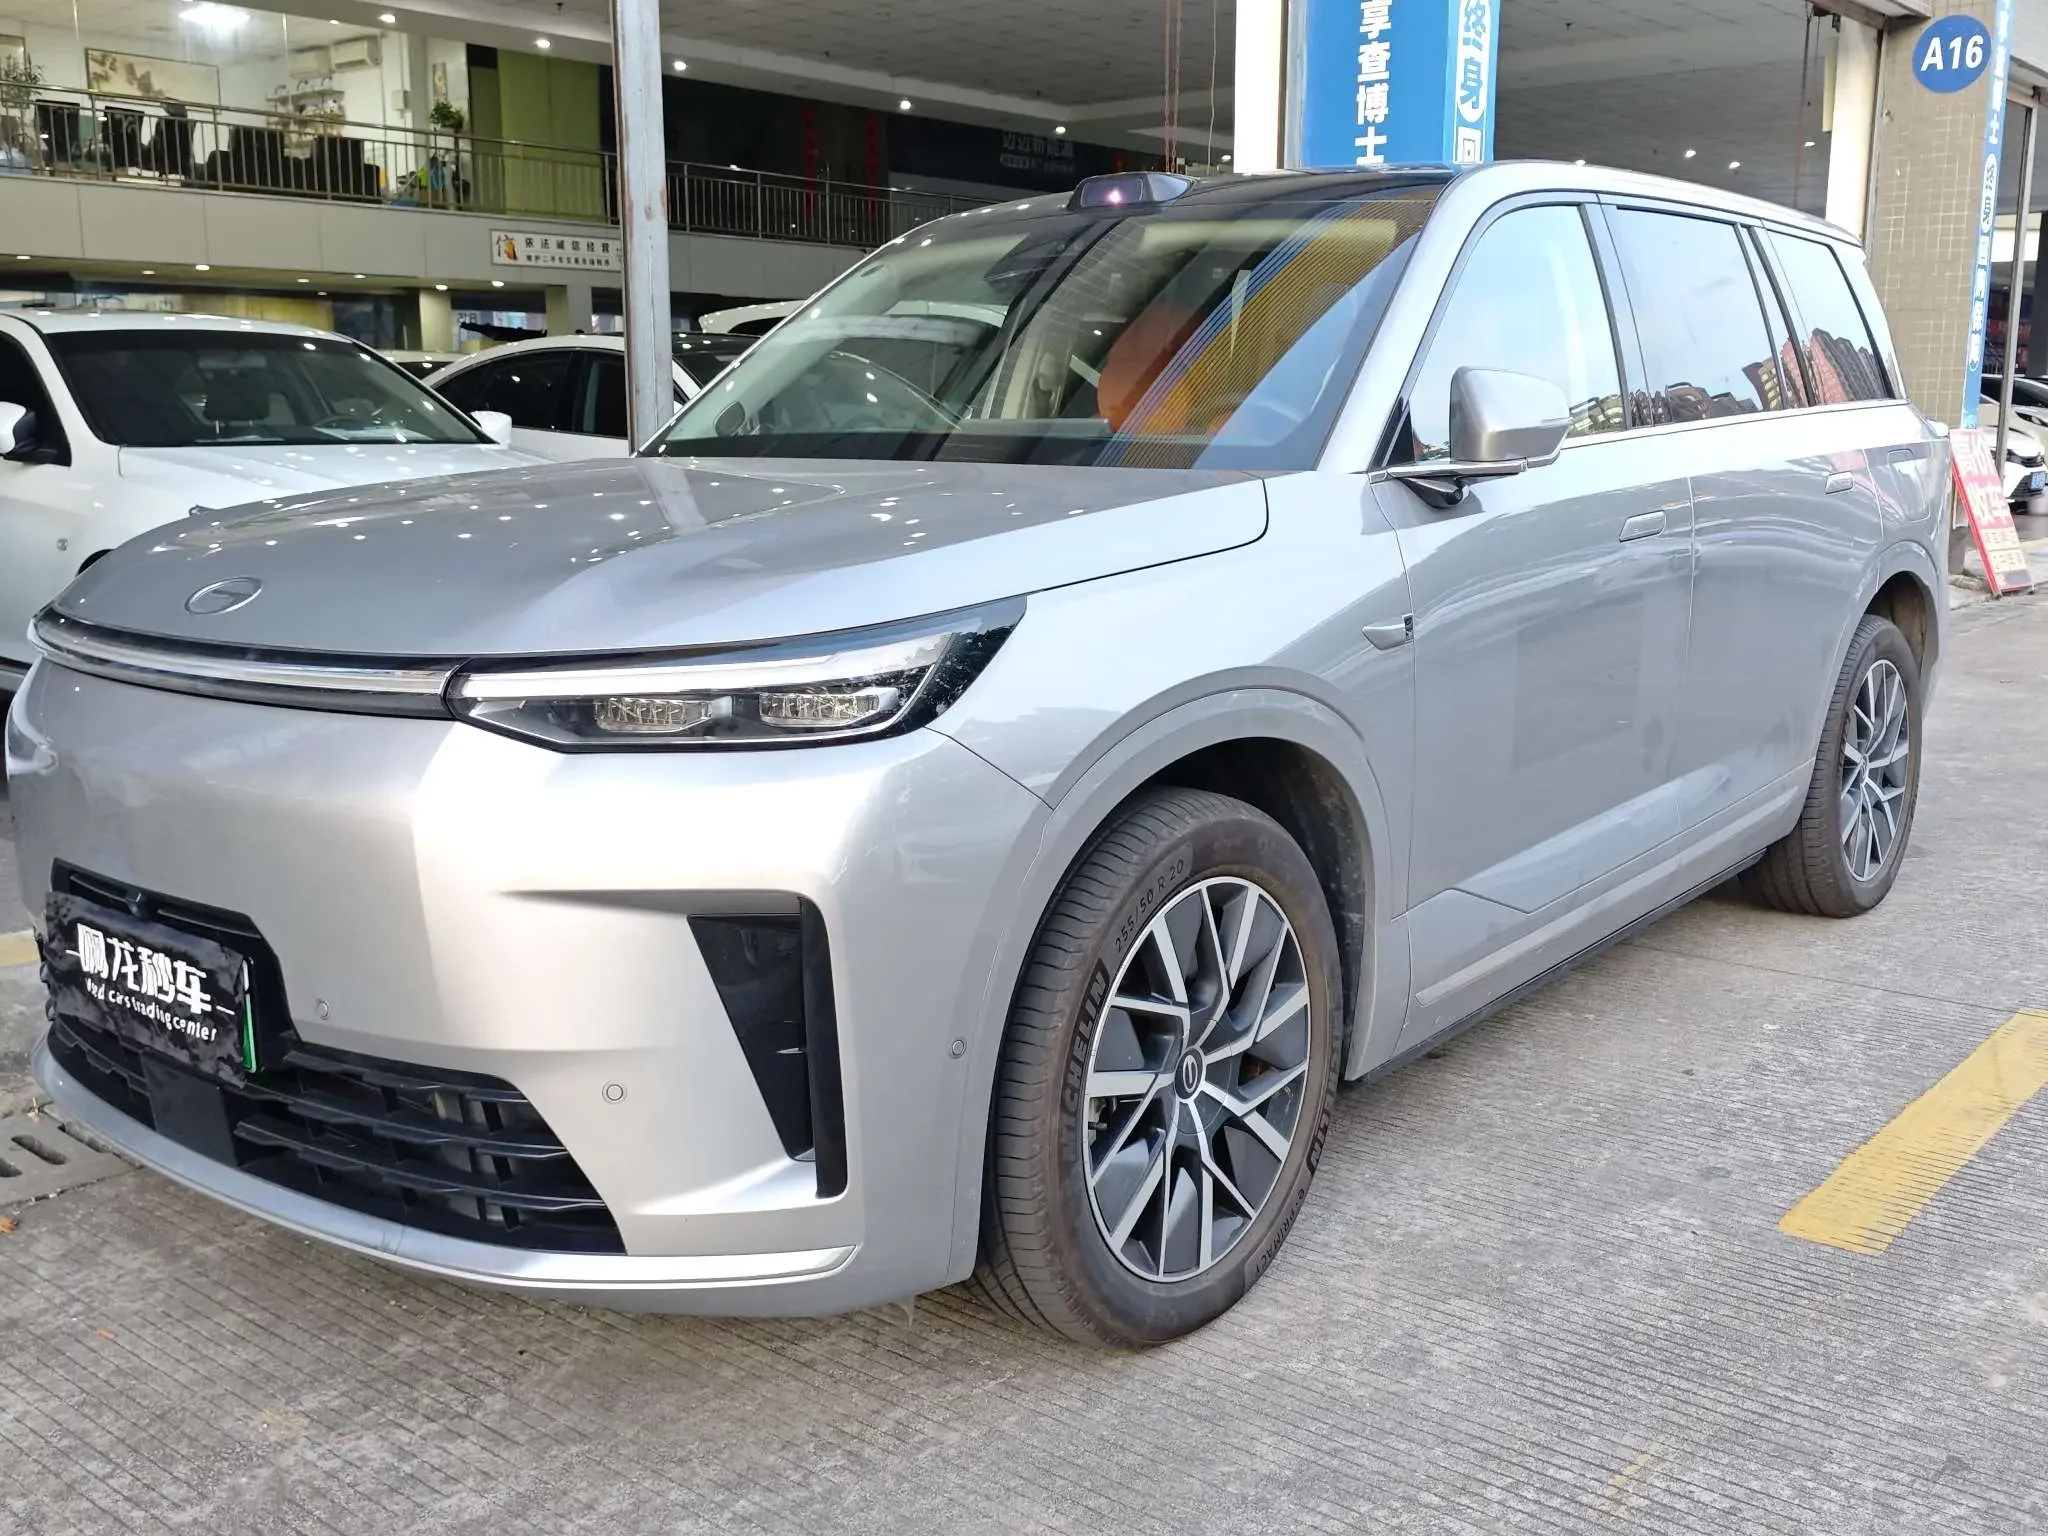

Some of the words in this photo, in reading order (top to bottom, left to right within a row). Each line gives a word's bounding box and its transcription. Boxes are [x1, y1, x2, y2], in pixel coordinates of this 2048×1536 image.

[1920, 35, 1984, 72] A16
[525, 237, 610, 254] 依法诚信经营
[1115, 889, 1154, 953] 255/50
[1157, 876, 1165, 891] R
[1169, 859, 1184, 881] 20
[172, 1016, 217, 1042] center
[1060, 968, 1109, 1163] MICHELIN
